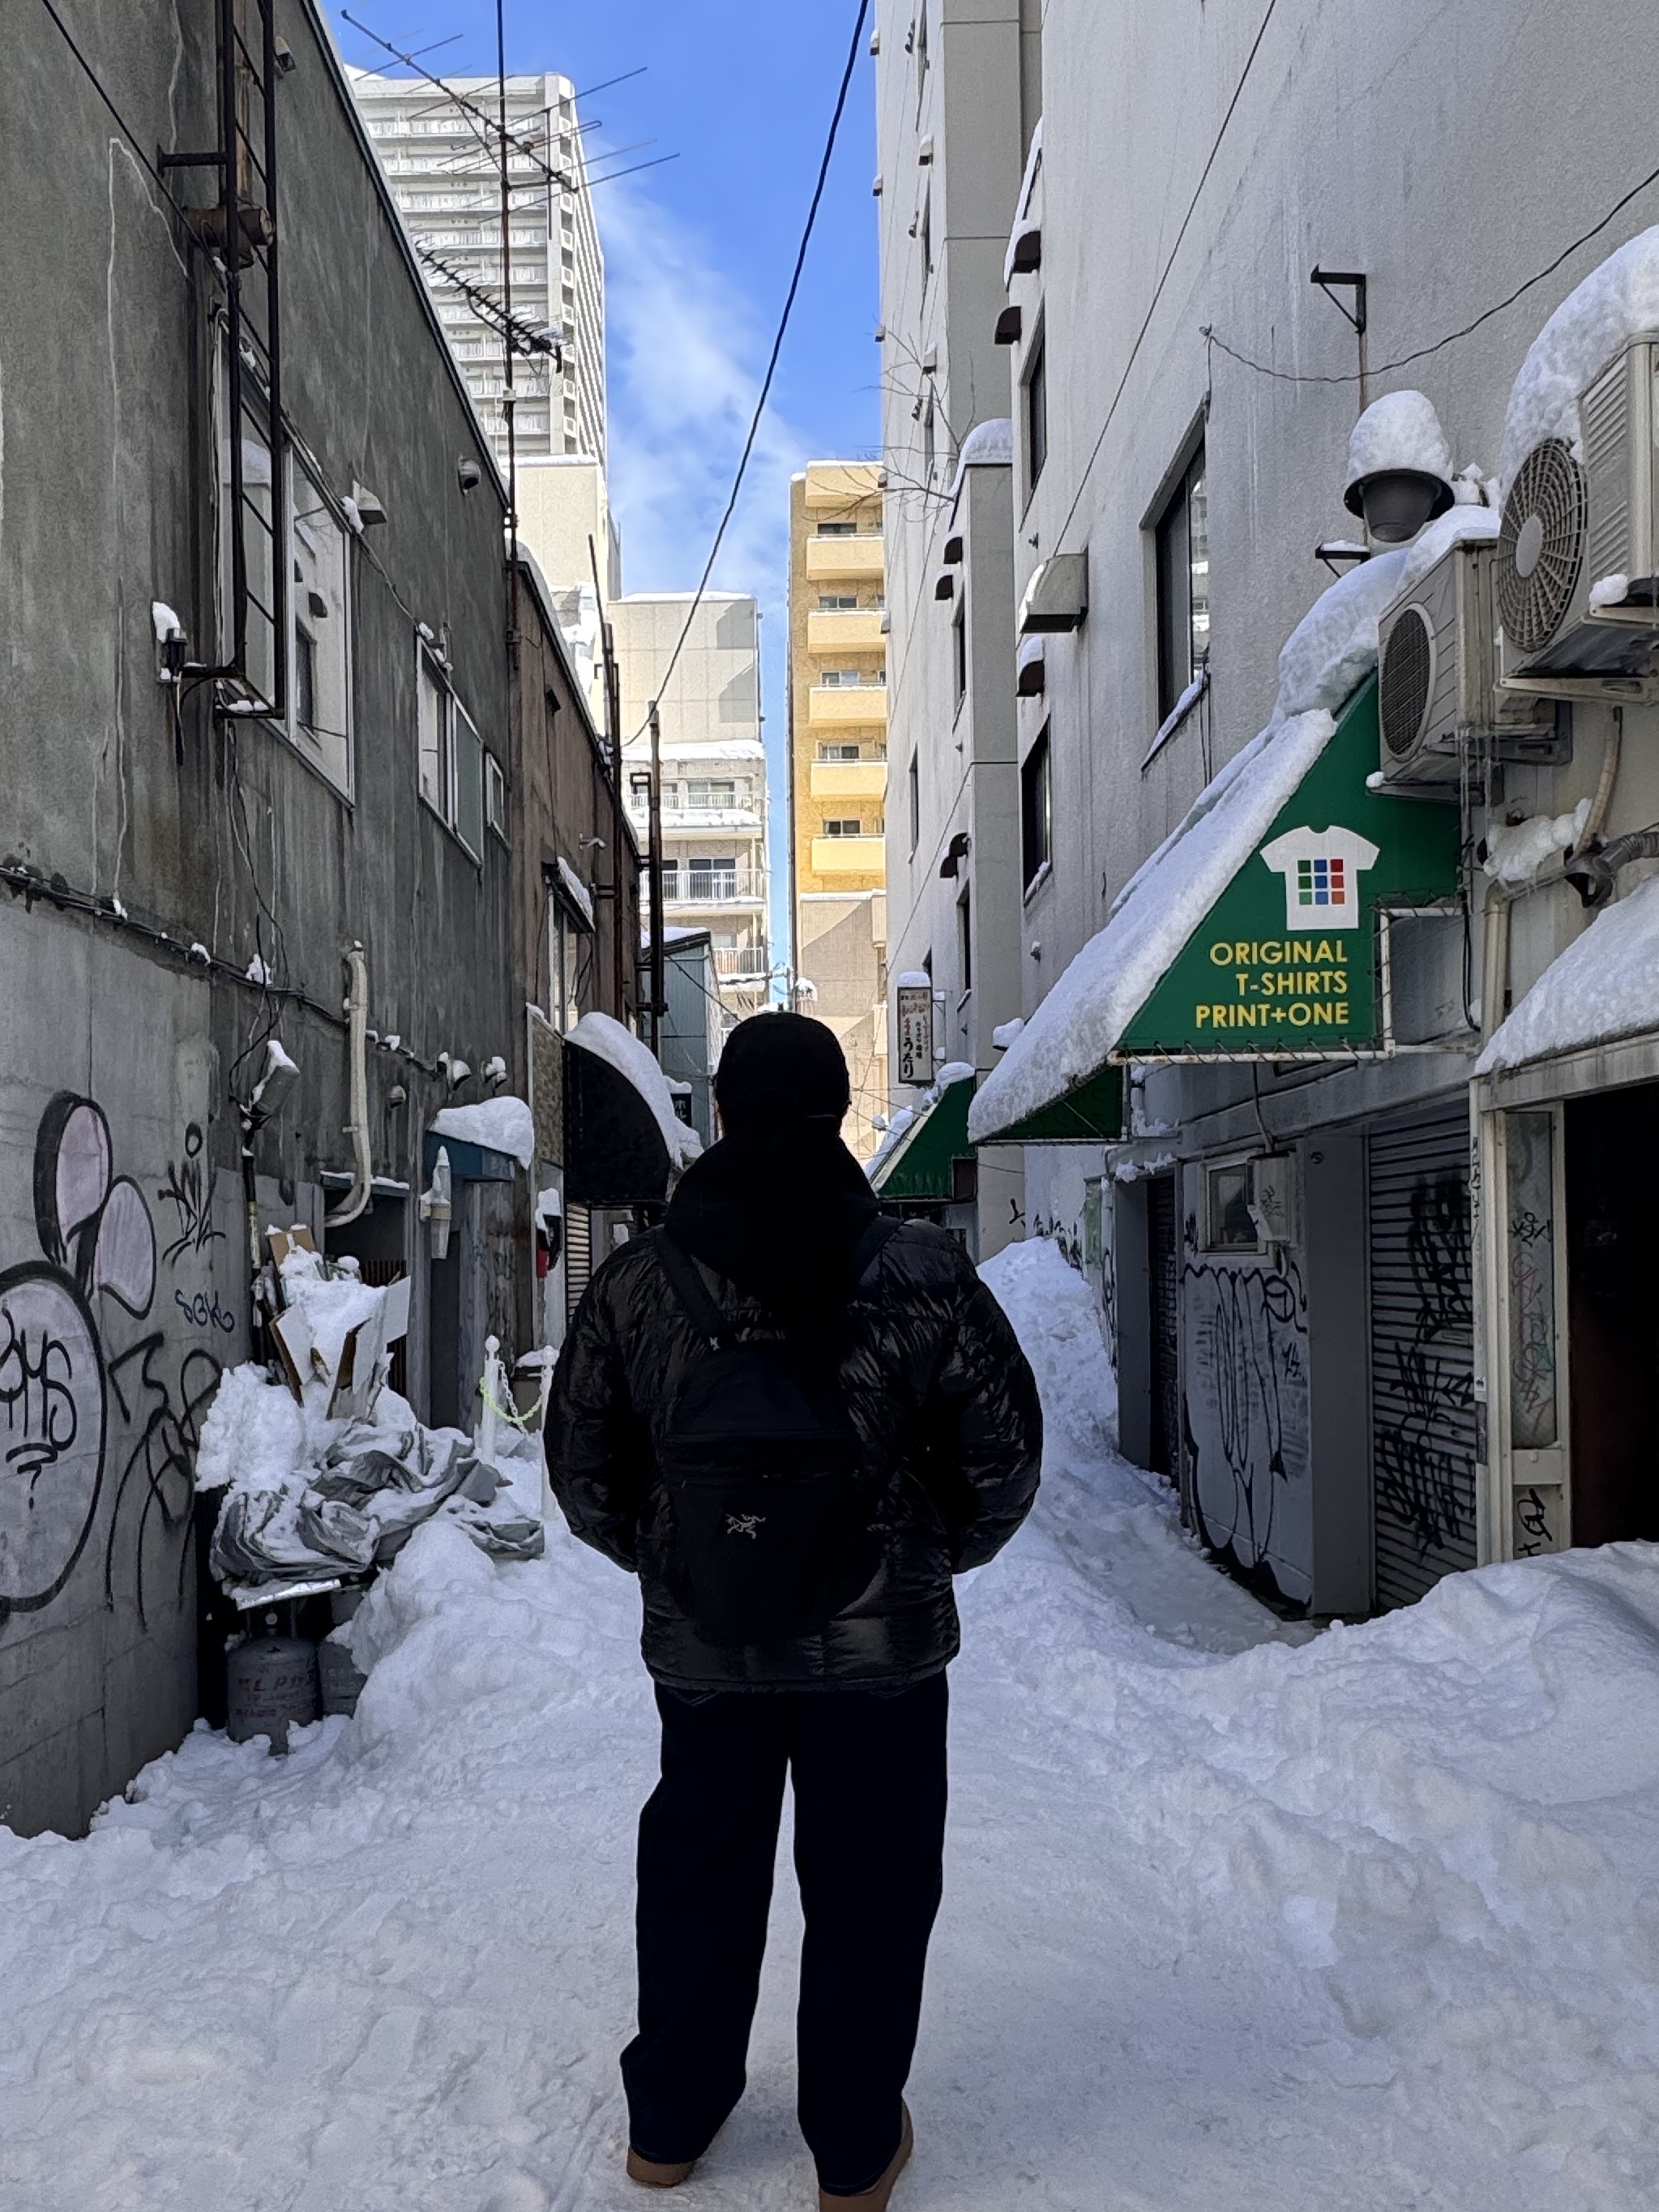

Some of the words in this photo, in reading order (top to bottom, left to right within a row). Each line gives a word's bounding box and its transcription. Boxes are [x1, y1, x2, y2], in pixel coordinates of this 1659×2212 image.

[1209, 940, 1348, 965] ORIGINAL
[1235, 970, 1348, 996] T-SHIRTS
[1195, 1002, 1349, 1028] PRINT+ONE
